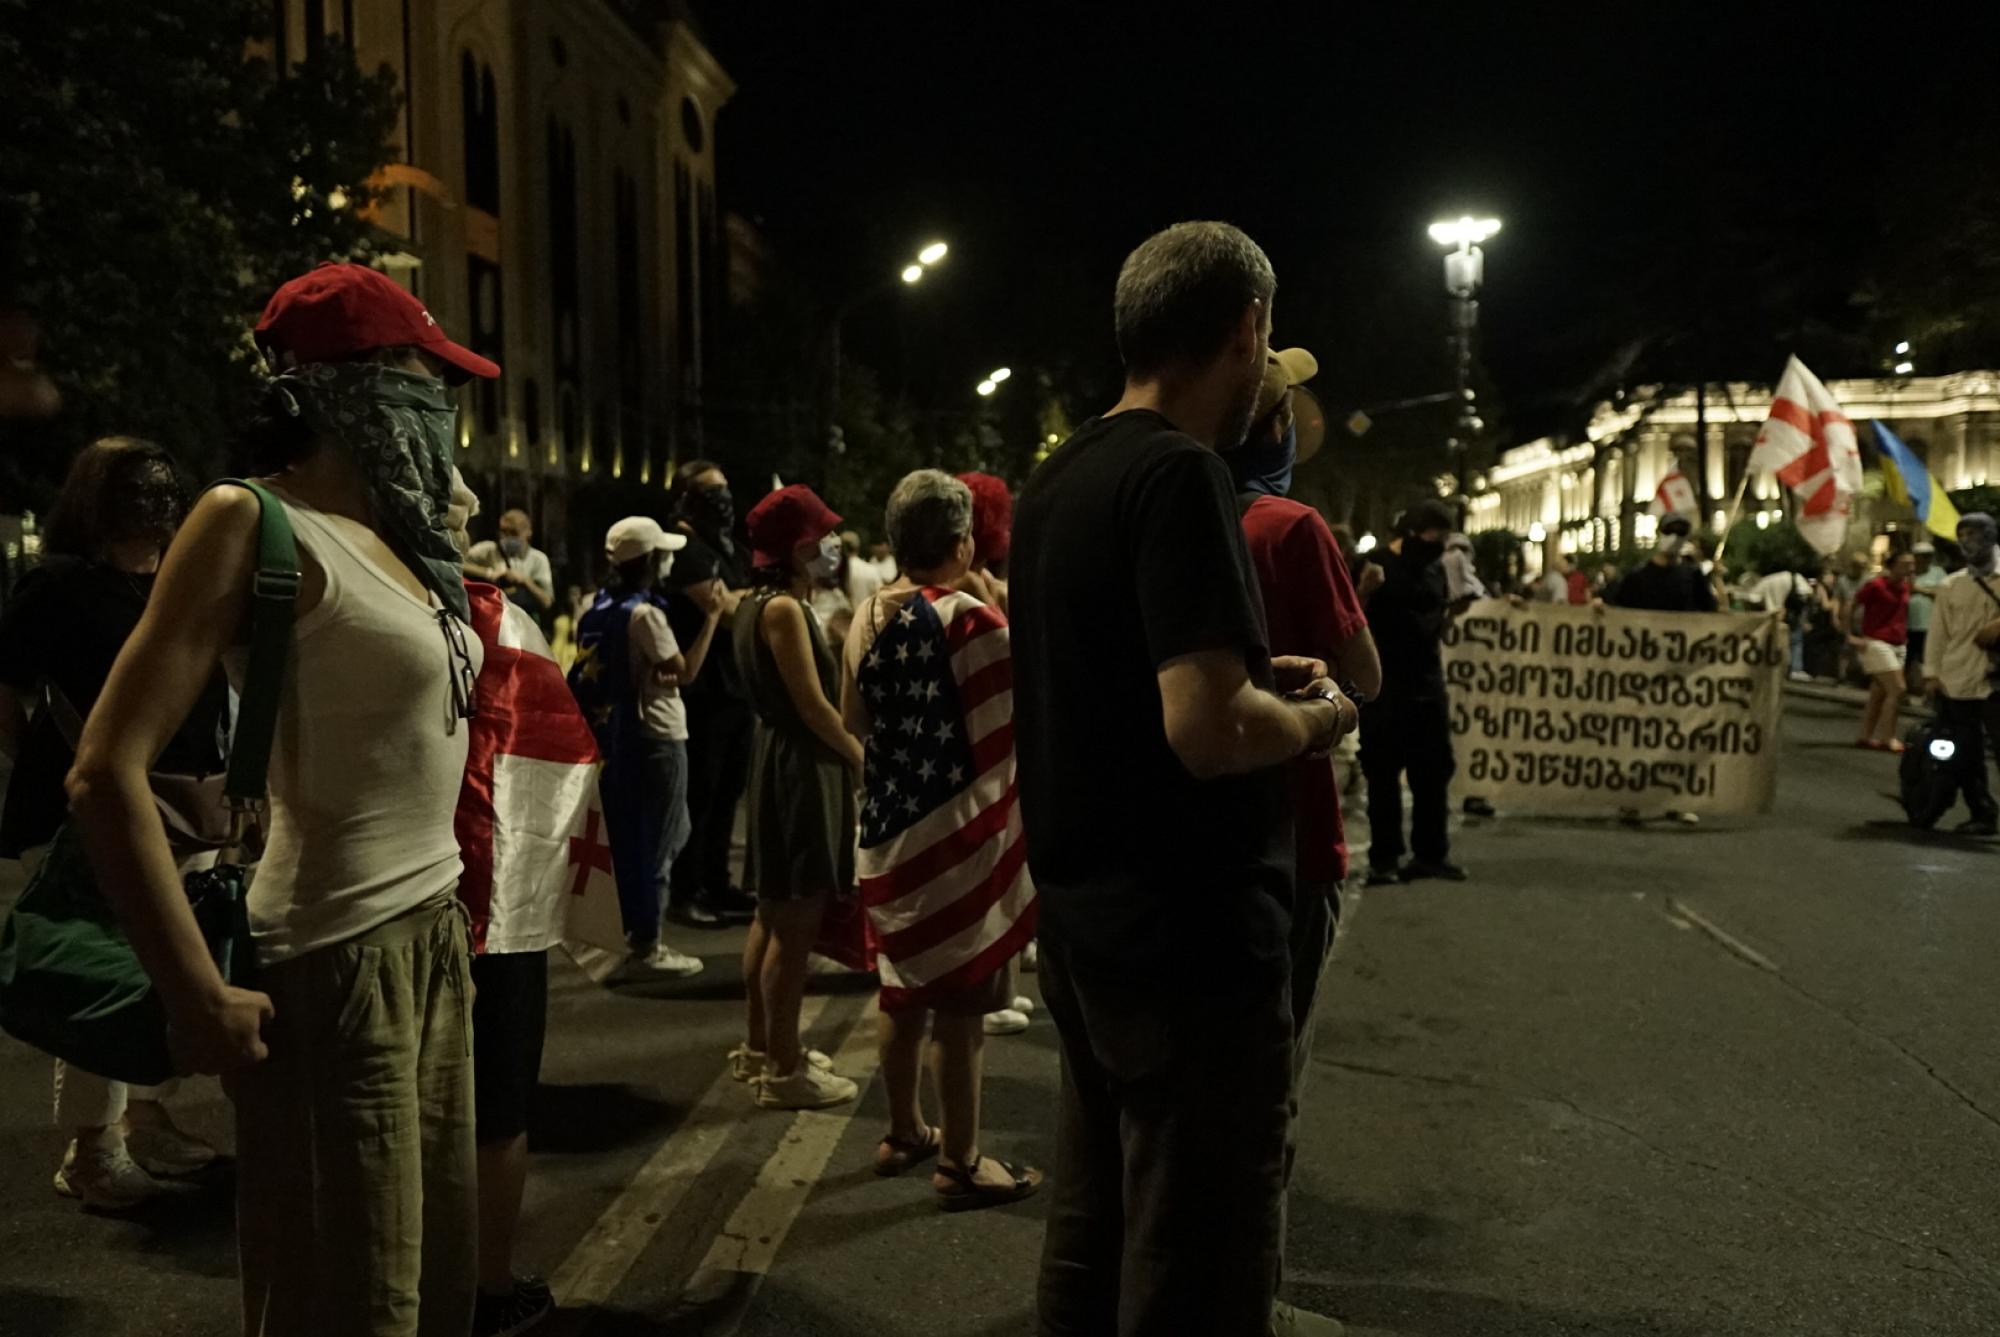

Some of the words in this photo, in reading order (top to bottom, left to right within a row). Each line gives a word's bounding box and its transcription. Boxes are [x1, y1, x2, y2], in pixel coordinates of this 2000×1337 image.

[1442, 618, 1539, 653] ალხი
[1555, 624, 1782, 666] იმსახურებს
[1447, 660, 1753, 709] დამოუკიდებელ
[1452, 702, 1761, 755] აზოგადოებრივ
